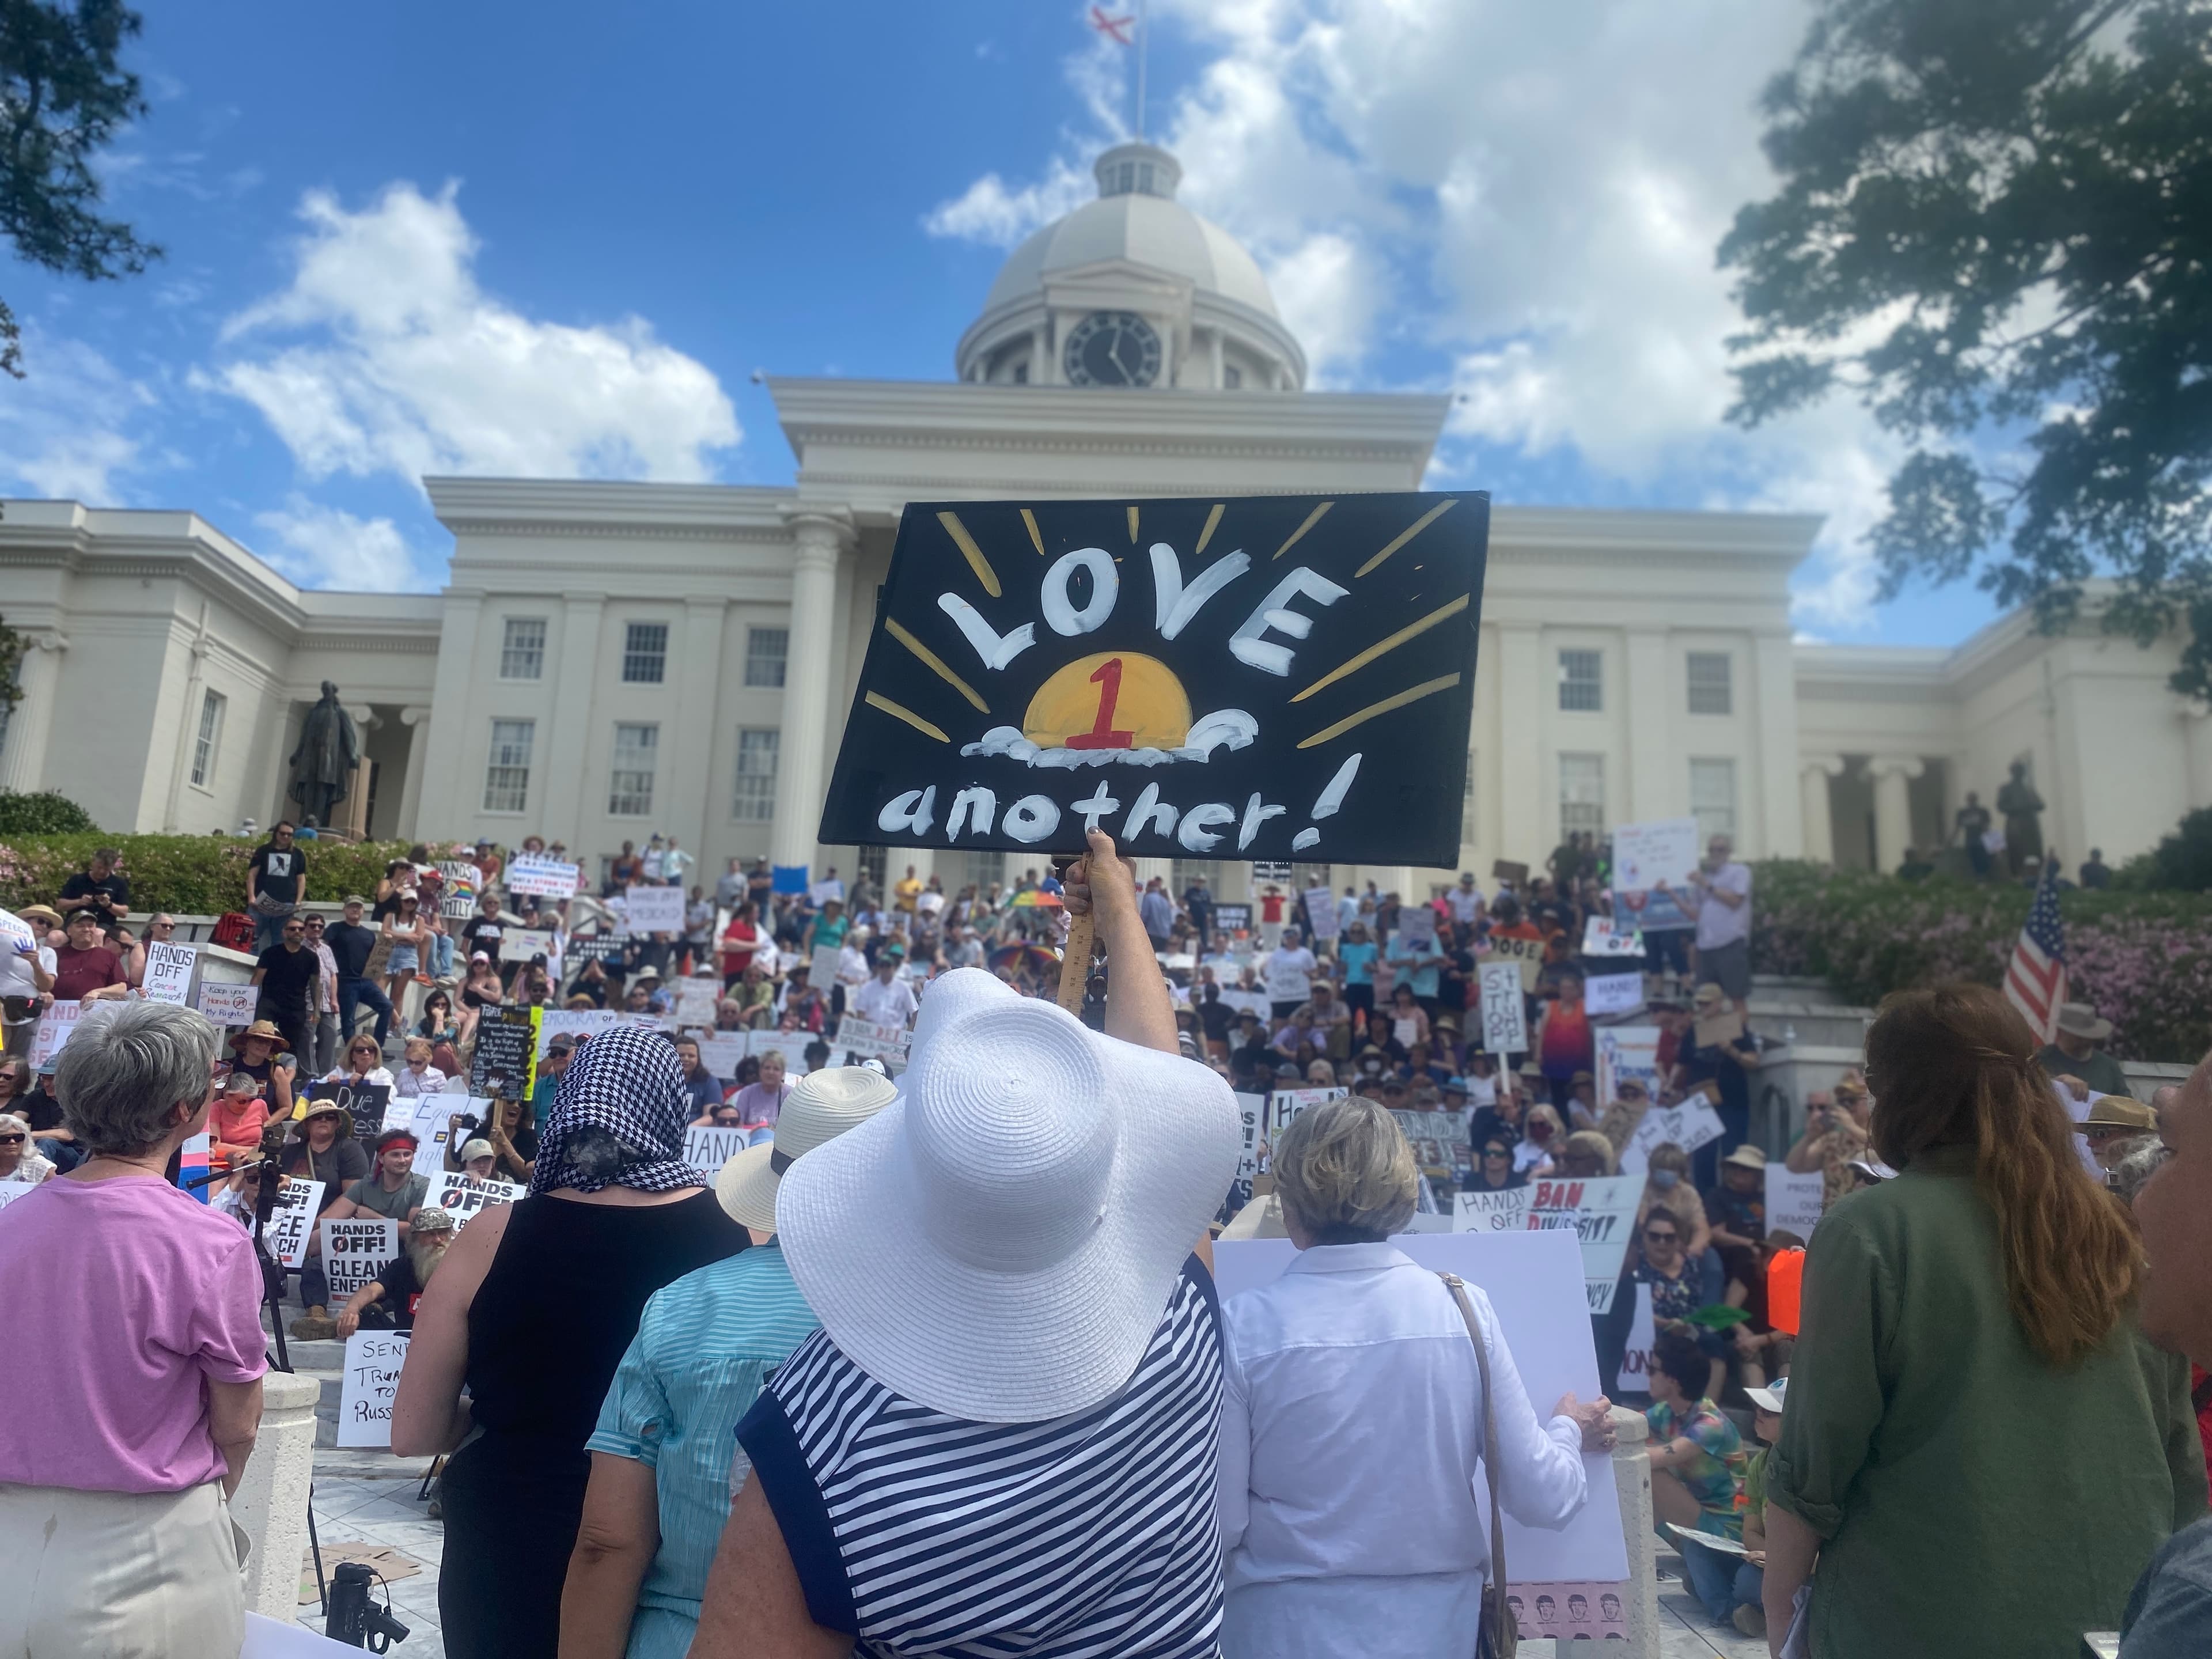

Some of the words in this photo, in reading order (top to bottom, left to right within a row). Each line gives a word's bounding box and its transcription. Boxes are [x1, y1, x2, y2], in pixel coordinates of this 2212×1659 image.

[937, 542, 1351, 677] LOVE
[1065, 657, 1133, 750] 1
[878, 752, 1362, 853] another!
[150, 944, 194, 967] HANDS
[154, 963, 183, 979] OFF
[542, 1012, 596, 1026] EMOCRA
[336, 1086, 374, 1113] Due
[1391, 1112, 1470, 1142] ANDS
[683, 1131, 745, 1164] HAND
[445, 1175, 513, 1197] HANDS
[1532, 1181, 1585, 1209] BAN
[1787, 1184, 1823, 1194] PROTE
[440, 1189, 510, 1211] OFF
[1461, 1188, 1525, 1214] HANDS
[278, 1215, 305, 1237] EE
[331, 1225, 385, 1235] HANDS
[1491, 1209, 1522, 1230] OFF
[1775, 1213, 1818, 1226] DEMOC
[332, 1236, 385, 1253] OFF!
[329, 1260, 389, 1278] CLEAN
[375, 1387, 396, 1398] TO
